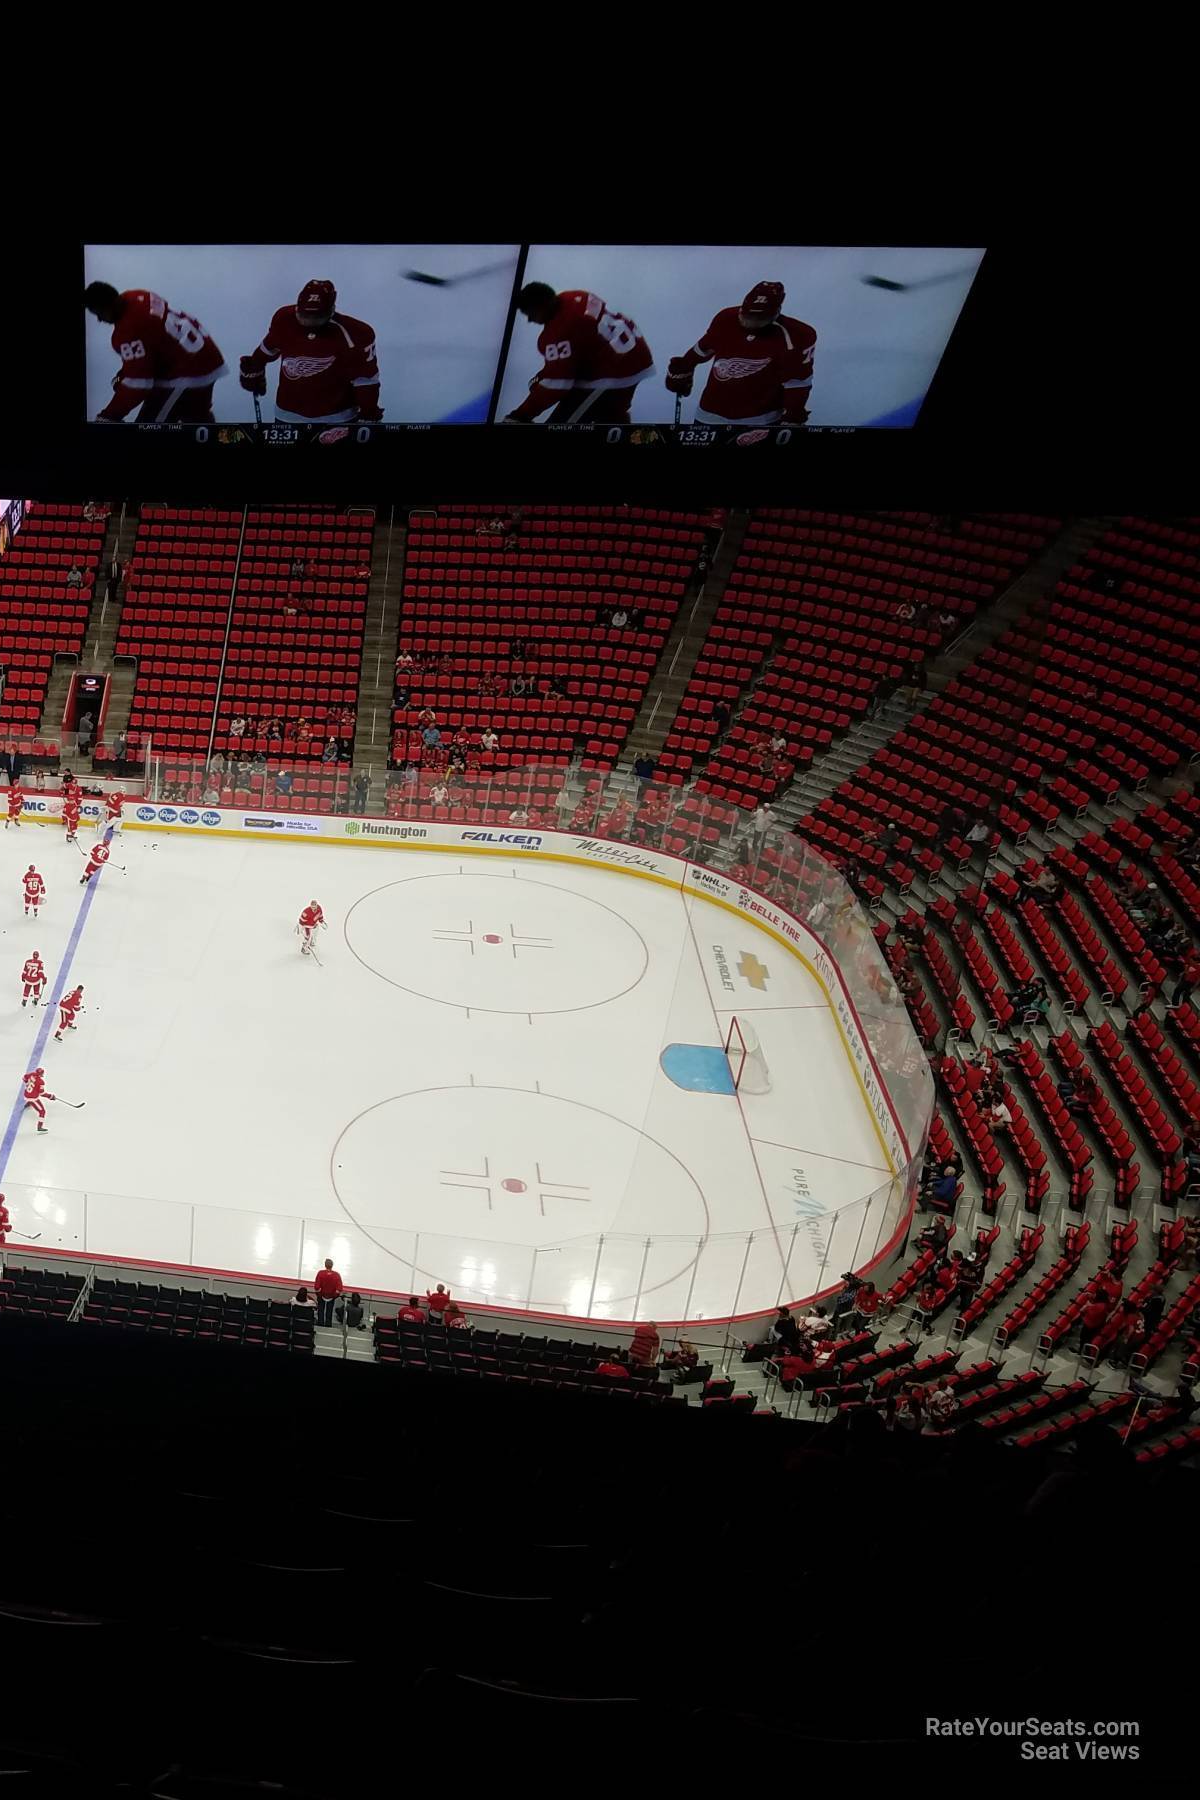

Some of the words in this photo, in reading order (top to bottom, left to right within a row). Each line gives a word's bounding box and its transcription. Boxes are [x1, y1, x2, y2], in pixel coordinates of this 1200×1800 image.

[120, 339, 146, 361] 83
[545, 340, 572, 362] 83
[195, 425, 209, 443] 0
[261, 428, 300, 441] 13:31
[356, 426, 371, 444] 0
[606, 426, 622, 443] 0
[677, 430, 718, 442] 13:31
[775, 428, 793, 445] 0
[22, 801, 47, 812] MC
[76, 805, 99, 816] OCS
[361, 822, 427, 839] Huntington
[461, 831, 542, 845] FALKEN
[750, 899, 780, 926] BELLE
[781, 921, 801, 943] TIRE
[26, 966, 38, 978] 72
[711, 944, 735, 992] CHEVROLET
